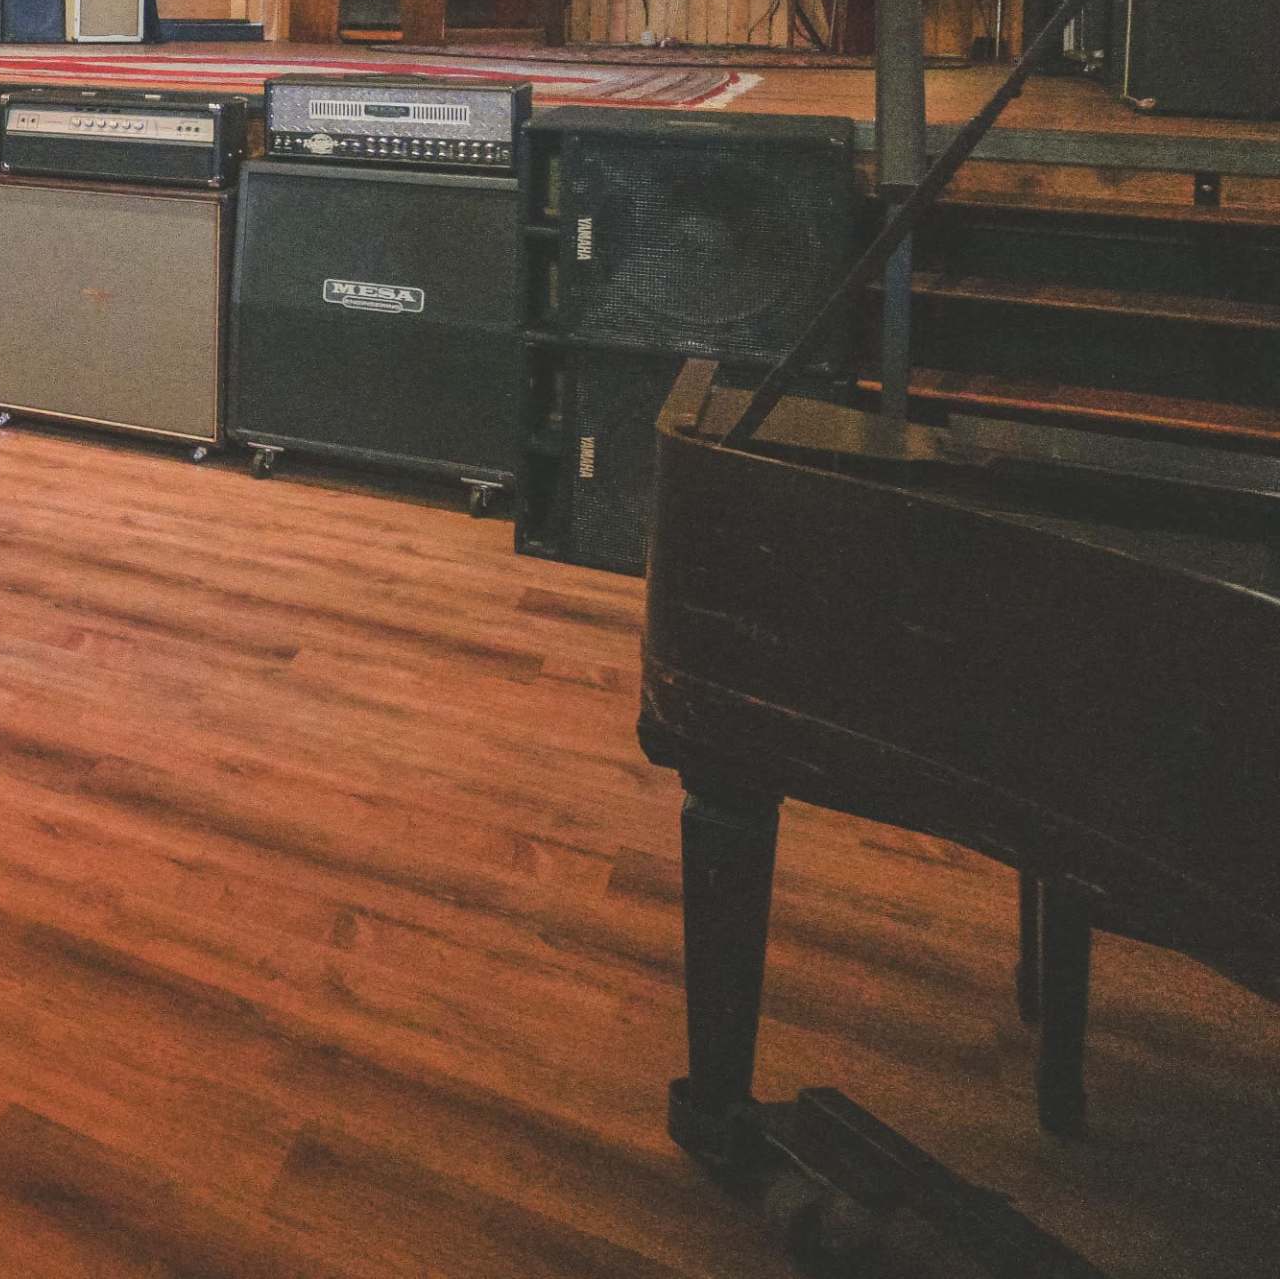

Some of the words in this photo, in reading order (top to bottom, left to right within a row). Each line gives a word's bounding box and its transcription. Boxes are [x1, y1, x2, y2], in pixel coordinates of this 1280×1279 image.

[577, 218, 592, 260] YAMAHA
[332, 282, 417, 303] MESA
[579, 437, 595, 478] YAMAHA
